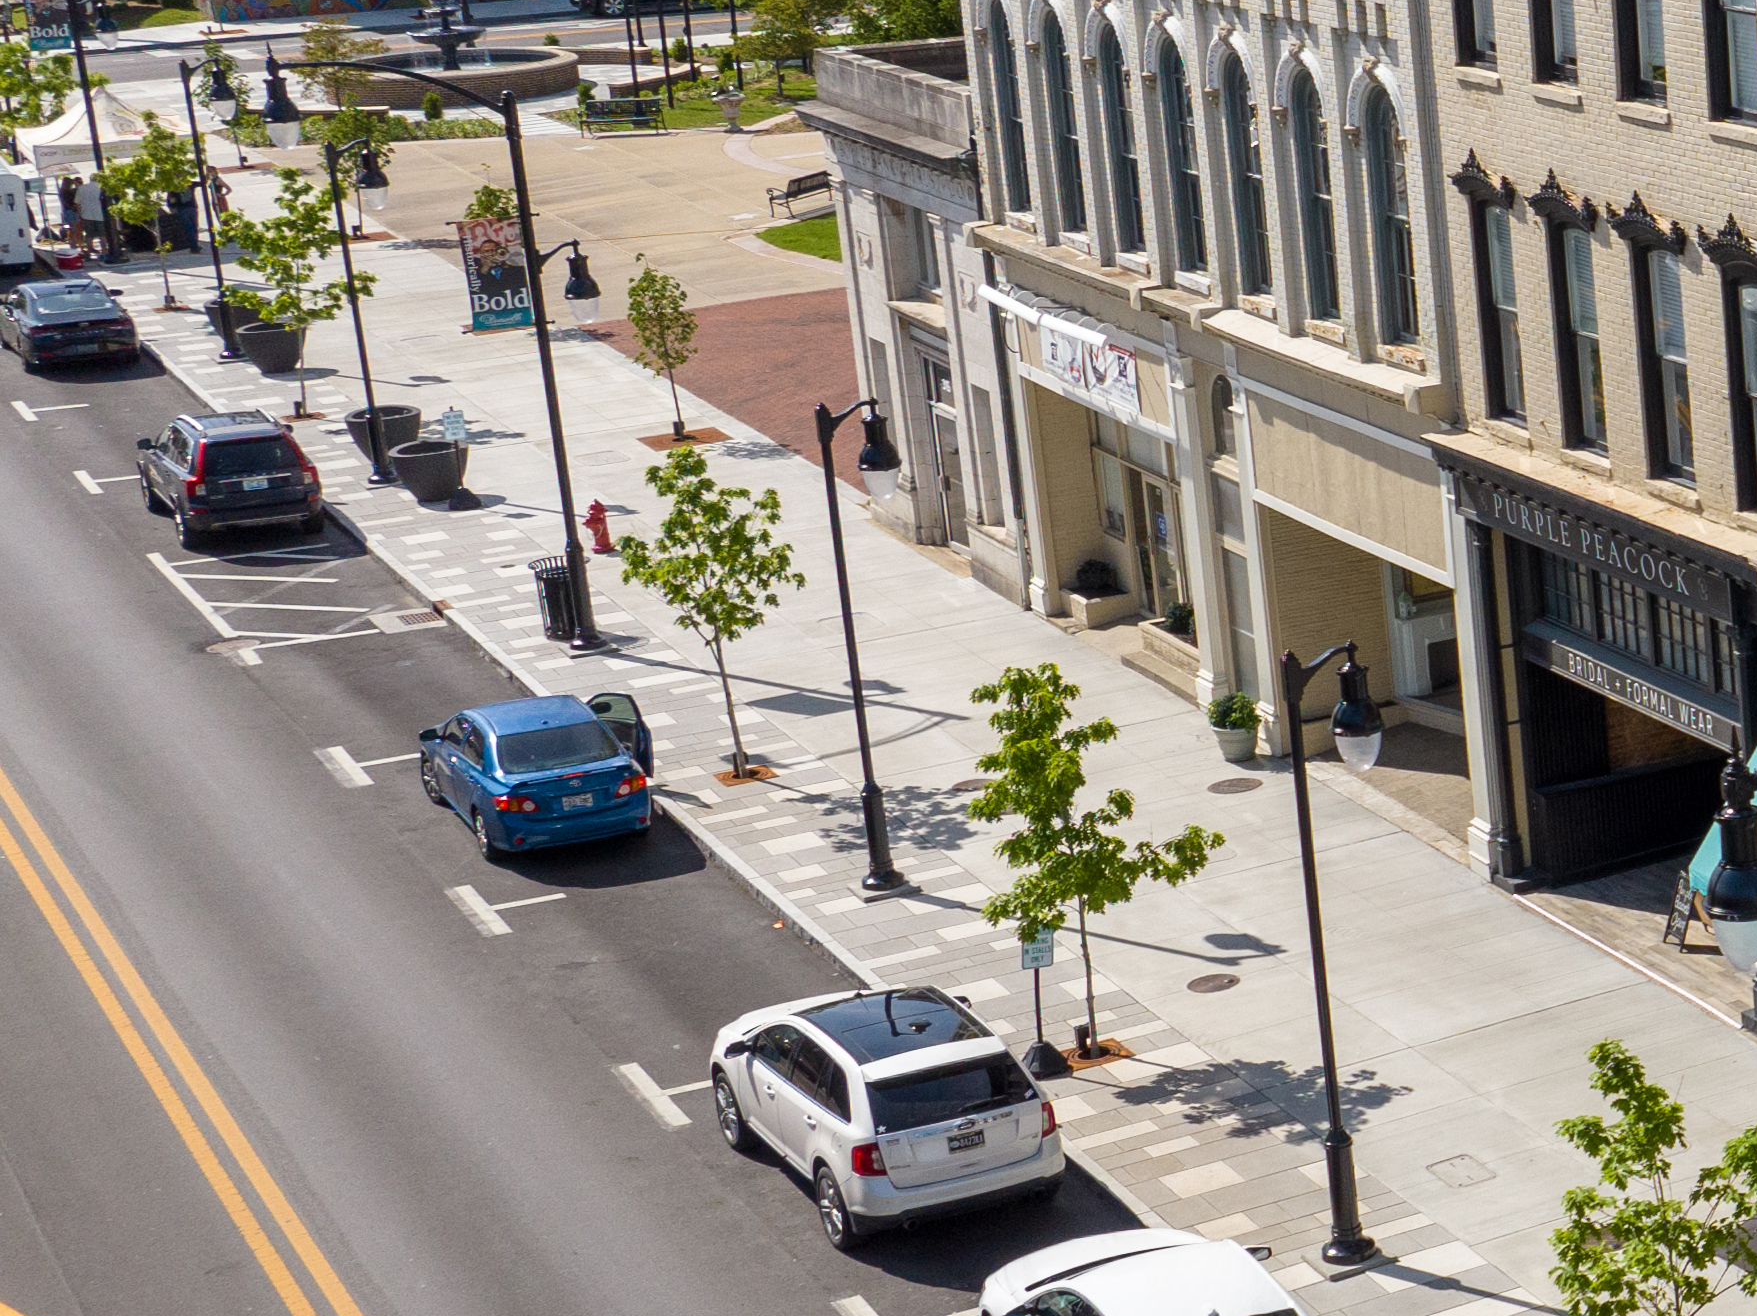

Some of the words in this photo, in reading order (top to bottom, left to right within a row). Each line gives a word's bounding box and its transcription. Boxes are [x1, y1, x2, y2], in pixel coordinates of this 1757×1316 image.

[29, 23, 70, 38] Bold
[462, 235, 482, 292] Historically
[471, 287, 531, 313] Bold
[1493, 493, 1572, 548] PURPLE
[1580, 528, 1690, 596] PEACOCK
[1568, 653, 1610, 690] BRIDAL
[1626, 679, 1674, 719] FORMAL
[1678, 702, 1714, 736] WEAR
